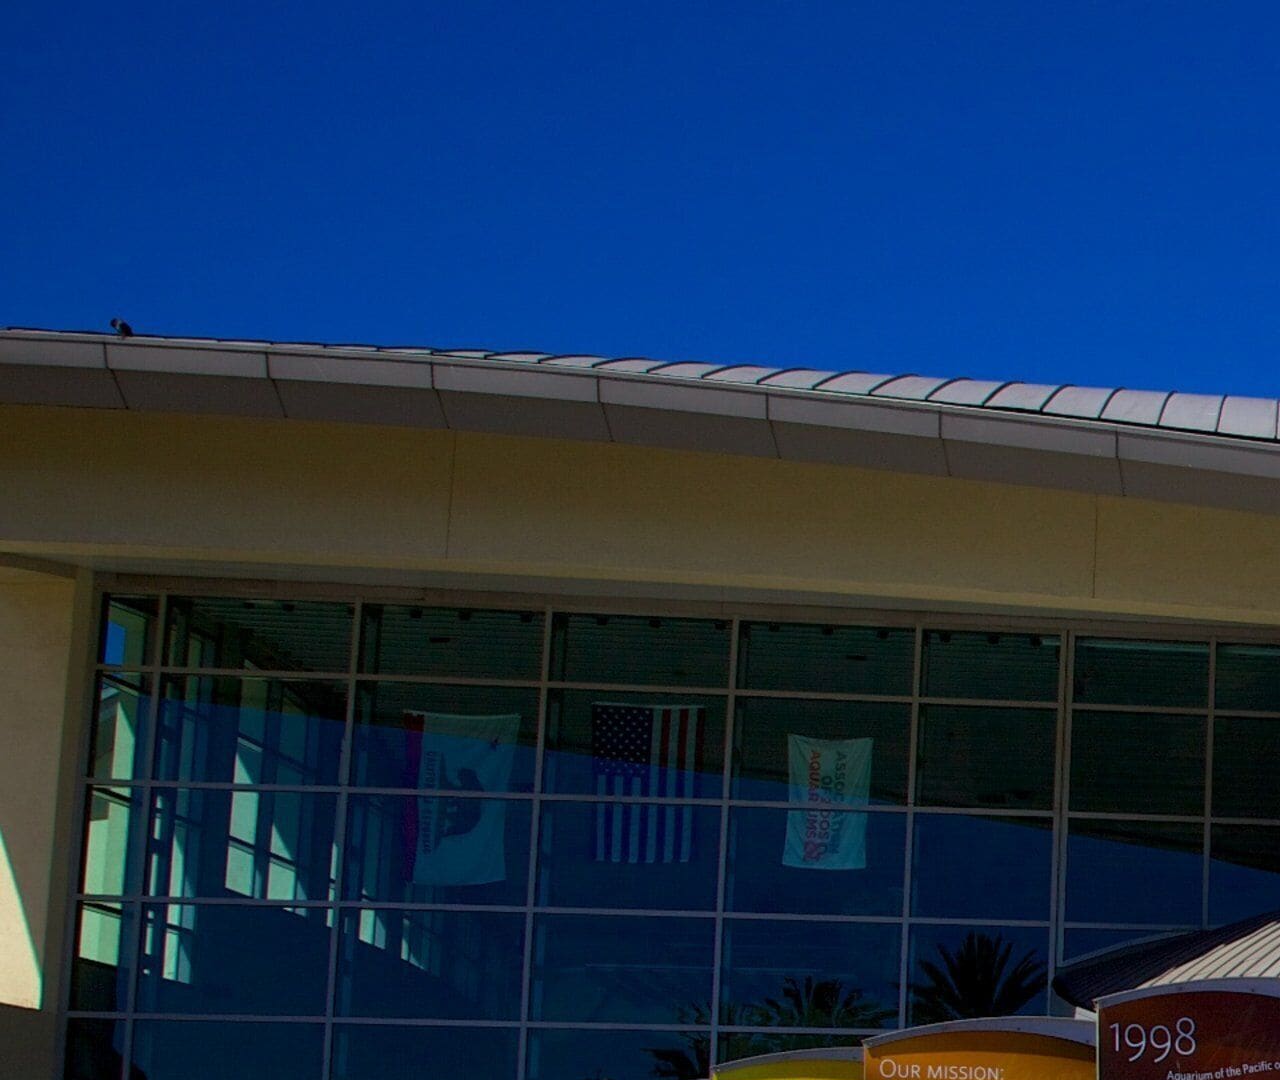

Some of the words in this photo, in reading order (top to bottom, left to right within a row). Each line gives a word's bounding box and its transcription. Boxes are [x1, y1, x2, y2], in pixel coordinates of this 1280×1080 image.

[1109, 1017, 1197, 1063] 1998
[879, 1058, 921, 1079] OUR
[927, 1064, 1005, 1080] MISSION:
[1214, 1068, 1224, 1079] of
[1225, 1066, 1242, 1078] the
[1242, 1061, 1273, 1075] Pacific
